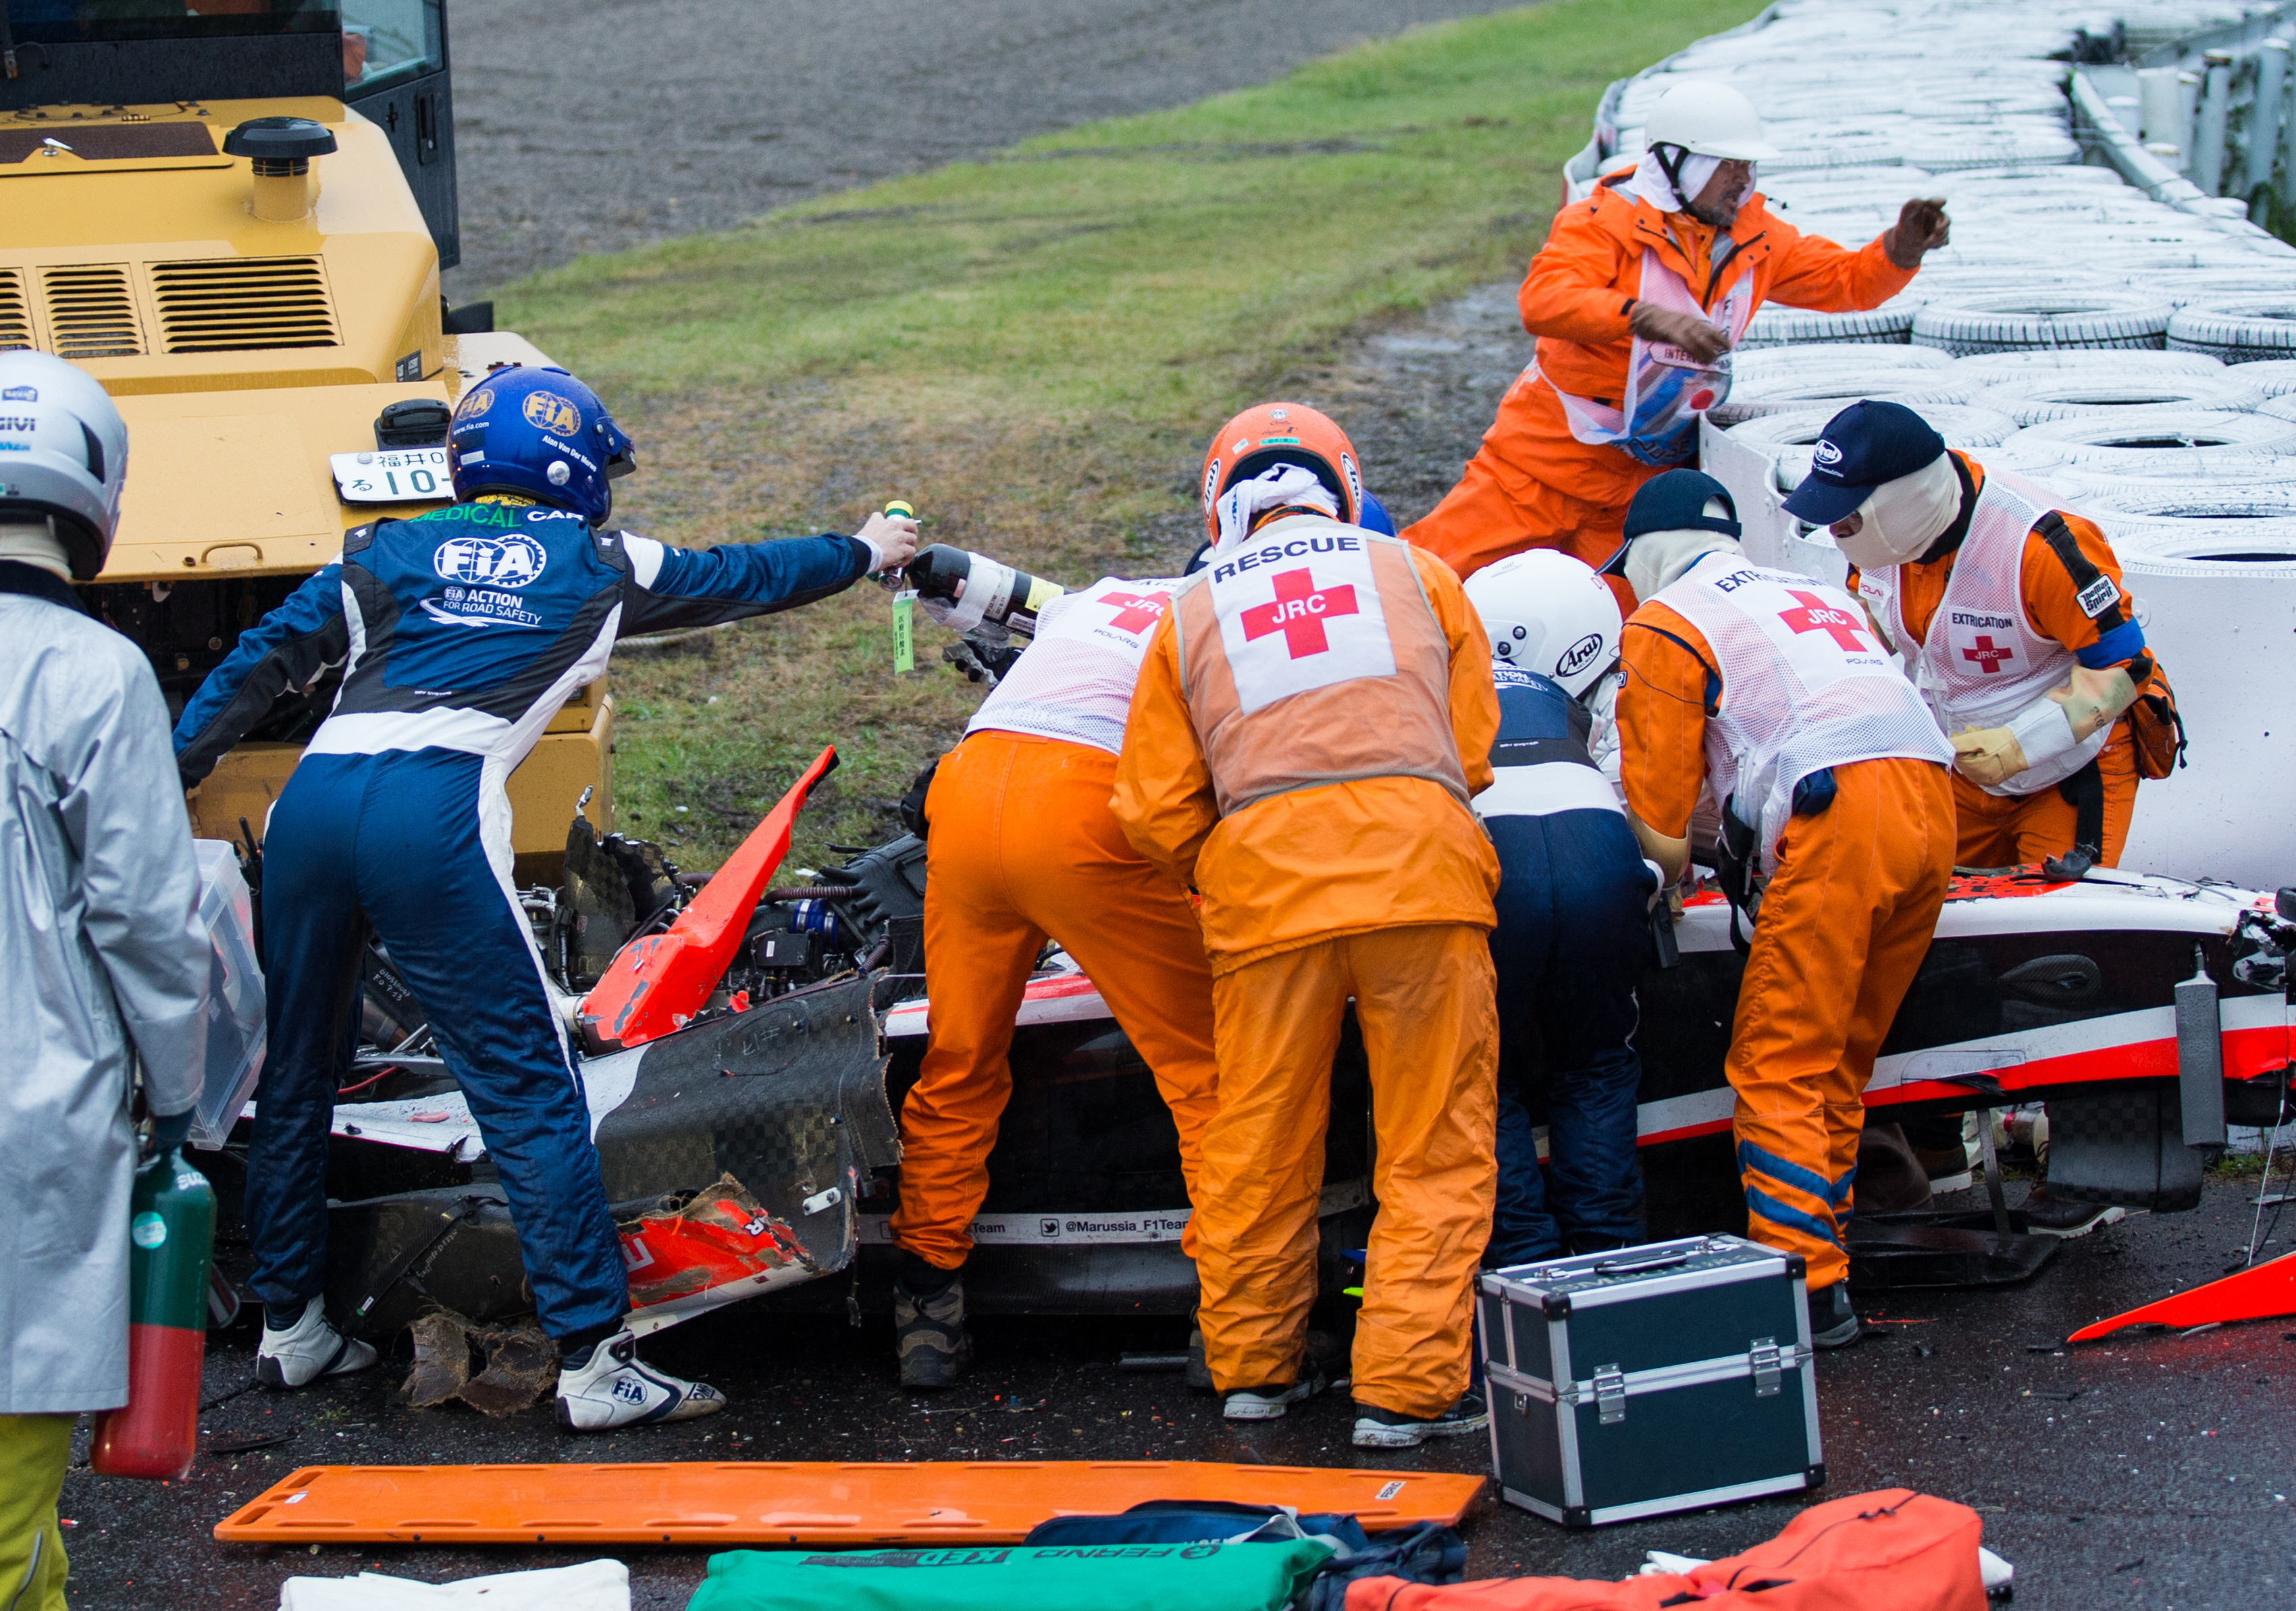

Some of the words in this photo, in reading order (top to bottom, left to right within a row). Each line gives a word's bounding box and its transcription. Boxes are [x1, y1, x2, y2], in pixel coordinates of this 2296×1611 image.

[453, 421, 490, 436] www.fia.com
[542, 435, 558, 448] Alan
[558, 442, 571, 454] Van
[570, 448, 581, 460] Der
[351, 479, 373, 492] る
[409, 505, 522, 528] MEDICAL
[527, 510, 584, 522] CAR
[1214, 537, 1361, 584] RESCUE
[467, 589, 523, 609] ACTION
[443, 600, 461, 610] FOR
[461, 602, 494, 614] ROAD
[495, 605, 542, 625] SAFETY
[1272, 594, 1326, 624] JRC
[1808, 609, 1847, 625] JRC
[1952, 612, 2013, 629] EXTRICATION
[1093, 629, 1140, 650] POLARG
[1561, 634, 1599, 676] Arai
[1846, 658, 1884, 666] POLARG
[1975, 650, 2000, 660] JRC
[1493, 670, 1530, 680] TION
[1509, 676, 1549, 692] SAFETY
[177, 1171, 209, 1190] SUZ
[972, 1223, 1006, 1234] Team
[916, 1550, 1003, 1566] KED
[1032, 1547, 1176, 1558] FERNO
